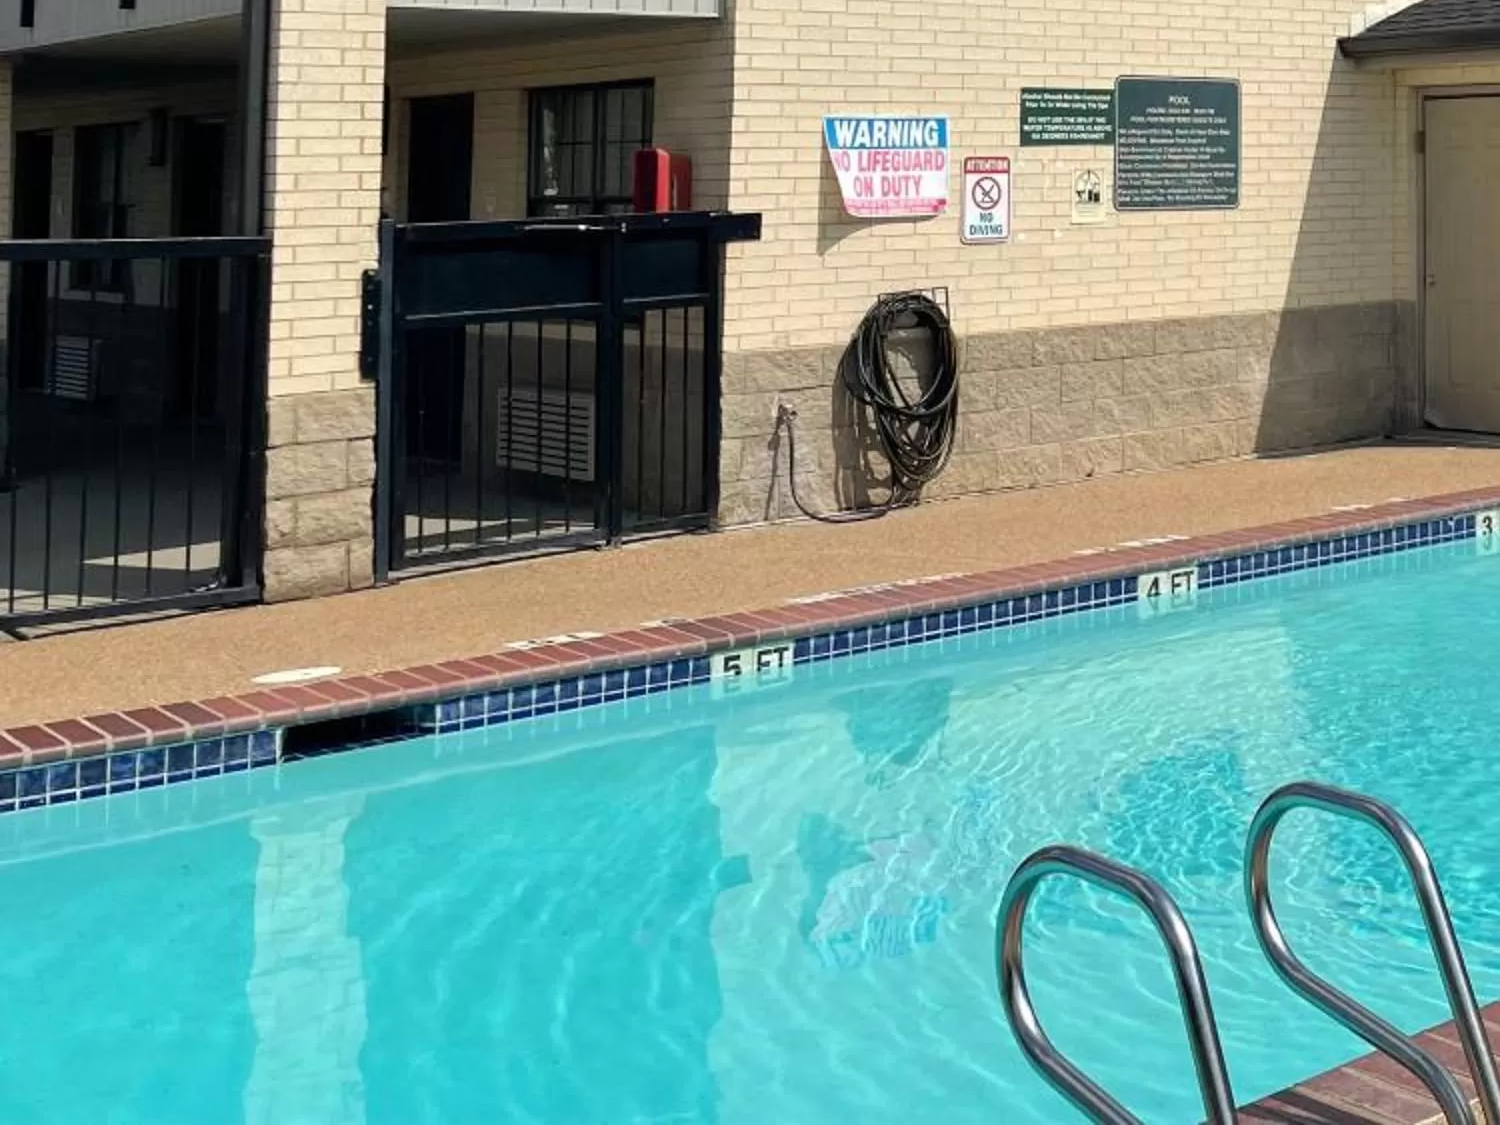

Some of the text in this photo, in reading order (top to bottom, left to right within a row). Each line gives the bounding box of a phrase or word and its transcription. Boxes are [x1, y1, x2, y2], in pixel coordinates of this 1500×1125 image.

[834, 120, 940, 147] WARNING
[832, 150, 945, 172] NO LIFEGUARD
[853, 175, 922, 197] ON DUTY
[979, 211, 994, 223] NO
[969, 224, 1003, 236] DIVING
[1482, 516, 1493, 536] 3
[1146, 570, 1194, 597] 4 FT
[723, 646, 789, 675] 5 FT
